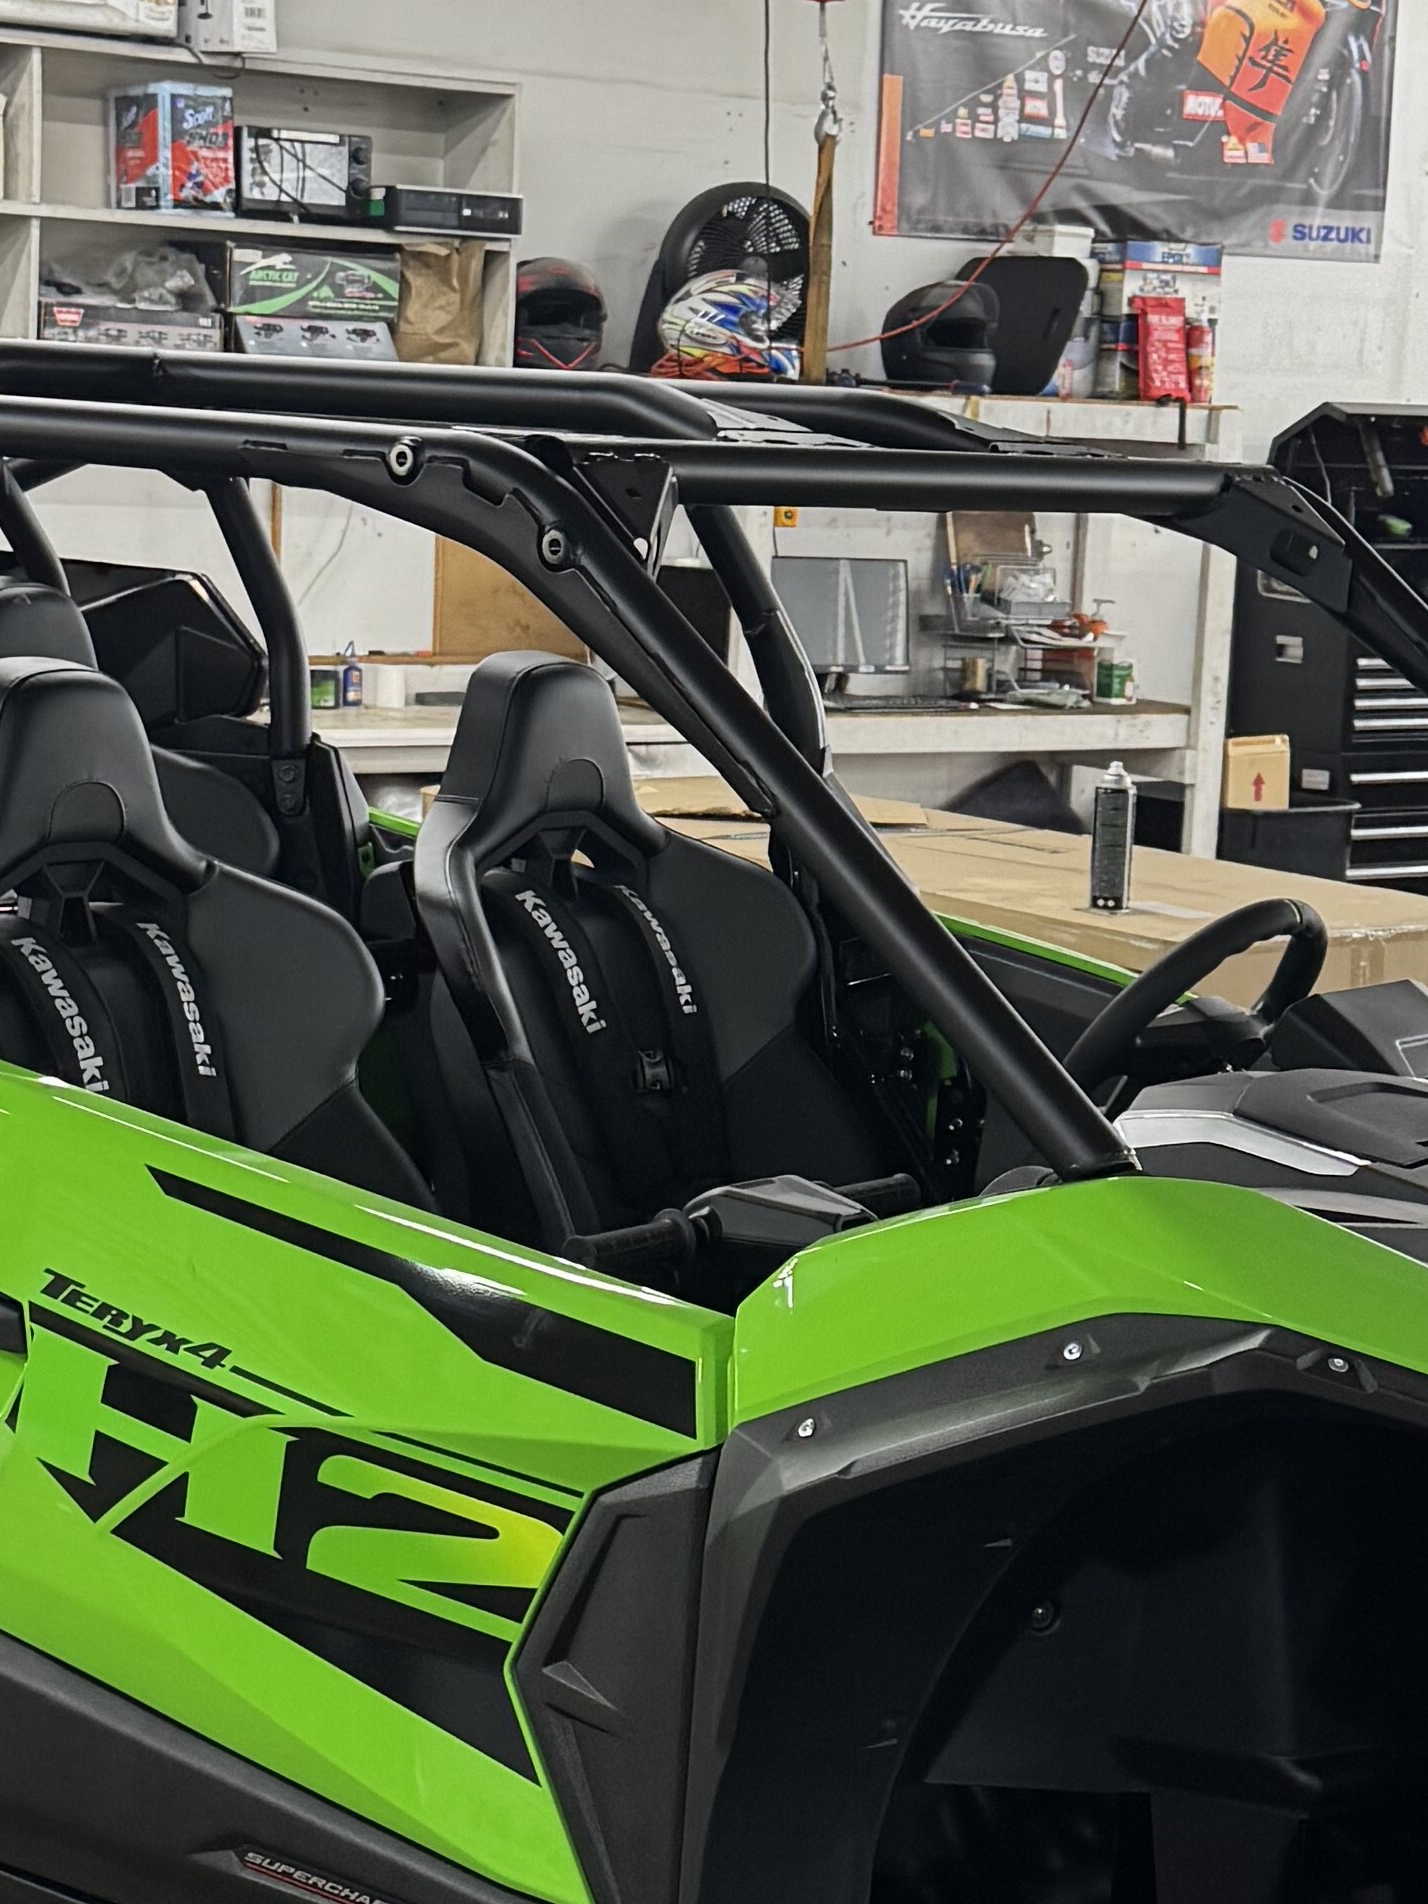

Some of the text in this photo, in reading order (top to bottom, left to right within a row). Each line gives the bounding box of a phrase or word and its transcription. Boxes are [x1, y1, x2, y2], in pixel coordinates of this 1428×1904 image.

[899, 2, 1049, 39] Hayabusa
[1291, 222, 1372, 245] SUZUKI
[11, 935, 110, 1092] Kawasaki
[135, 921, 219, 1078] Kawasaki
[514, 888, 607, 1037] Kawasaki
[616, 882, 699, 1017] Kawasaki
[13, 1320, 567, 1643] H2
